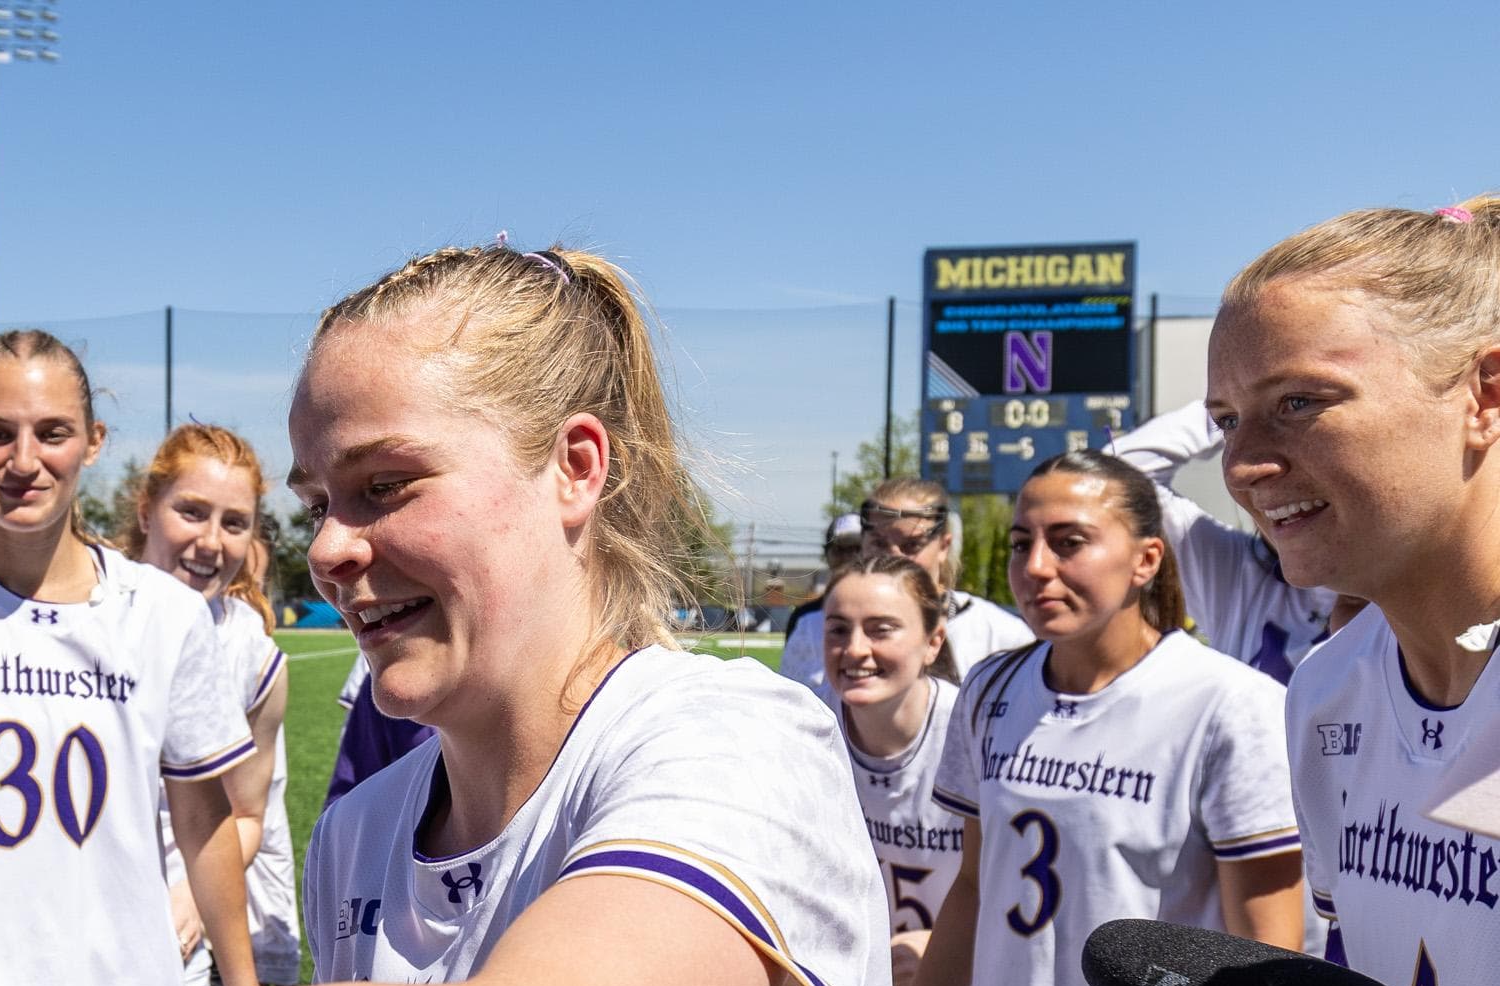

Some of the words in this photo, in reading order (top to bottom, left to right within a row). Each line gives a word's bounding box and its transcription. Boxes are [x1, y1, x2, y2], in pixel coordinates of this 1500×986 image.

[935, 252, 1125, 289] MICHIGAN
[1003, 331, 1053, 393] N
[981, 736, 1157, 804] Northwestern
[1004, 808, 1064, 938] 3
